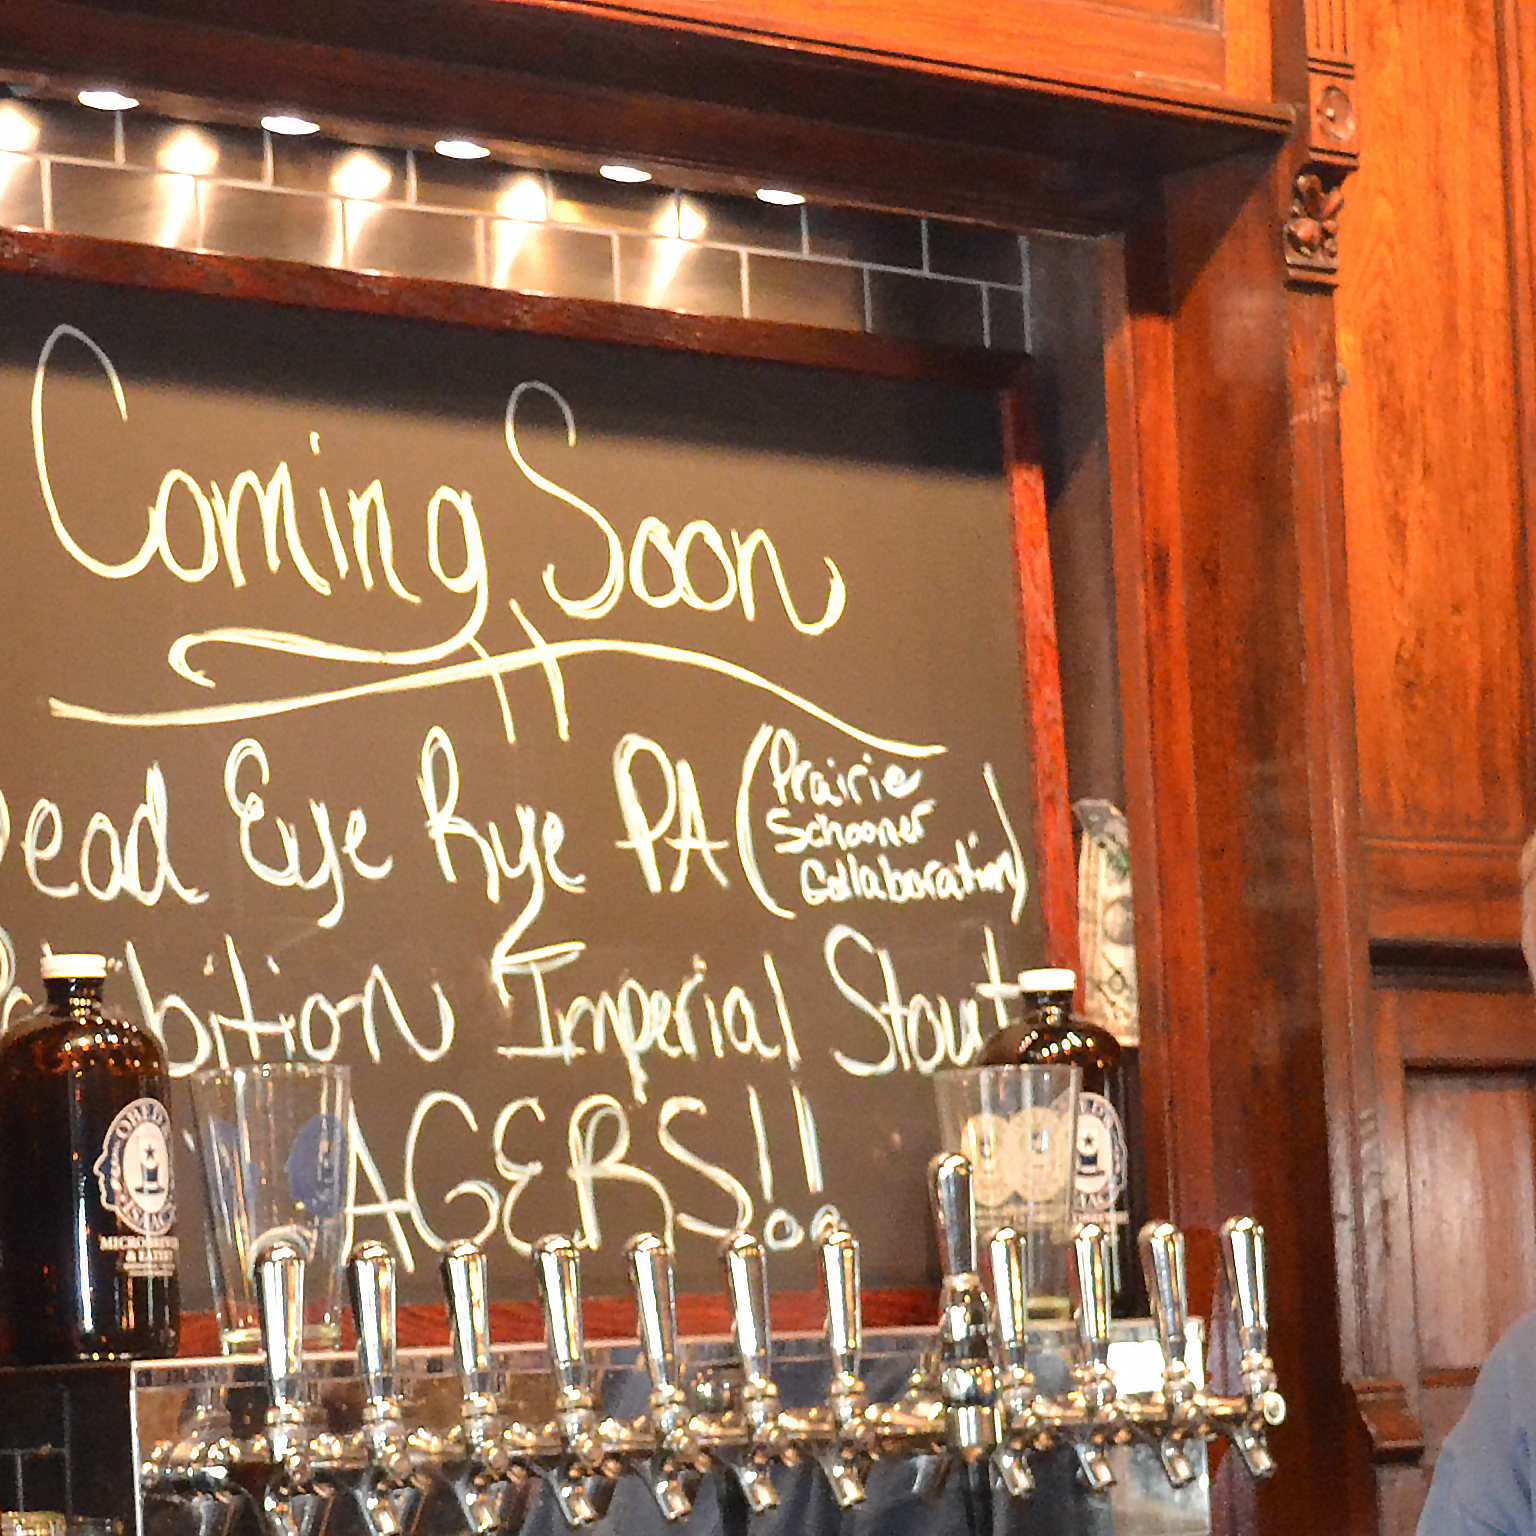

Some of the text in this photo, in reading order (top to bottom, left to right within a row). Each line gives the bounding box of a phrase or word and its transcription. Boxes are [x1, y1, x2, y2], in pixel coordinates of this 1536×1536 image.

[31, 324, 846, 688] Coming Soon
[224, 738, 393, 928] Eye
[417, 726, 585, 945] Rye
[766, 798, 937, 853] Schooner
[494, 942, 802, 1103] Imperial
[824, 925, 1022, 1076] Stout
[329, 1080, 841, 1273] AGERS!!
